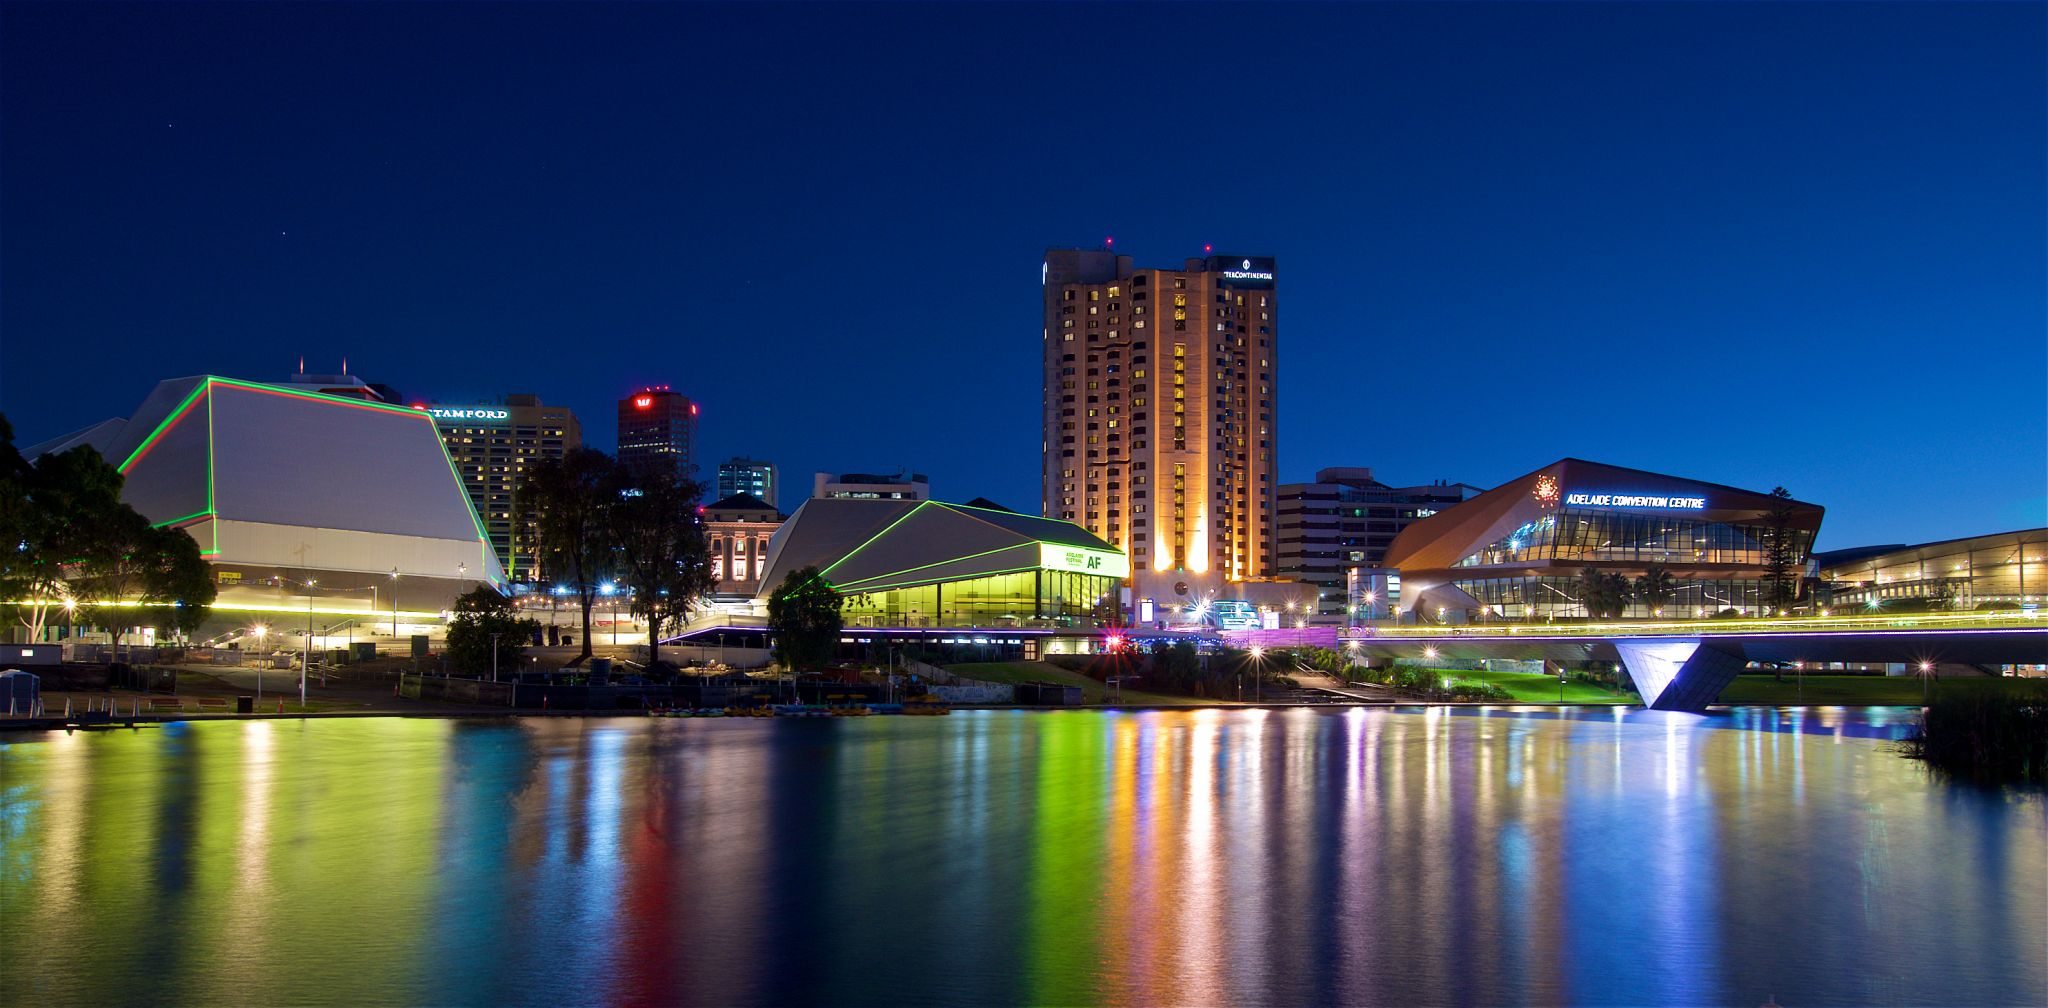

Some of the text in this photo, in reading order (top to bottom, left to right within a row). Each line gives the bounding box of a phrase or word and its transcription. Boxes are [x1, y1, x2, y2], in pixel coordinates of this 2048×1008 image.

[1566, 494, 1704, 508] ADELAIDE CONVENTION CENTRE
[1087, 556, 1101, 569] AF
